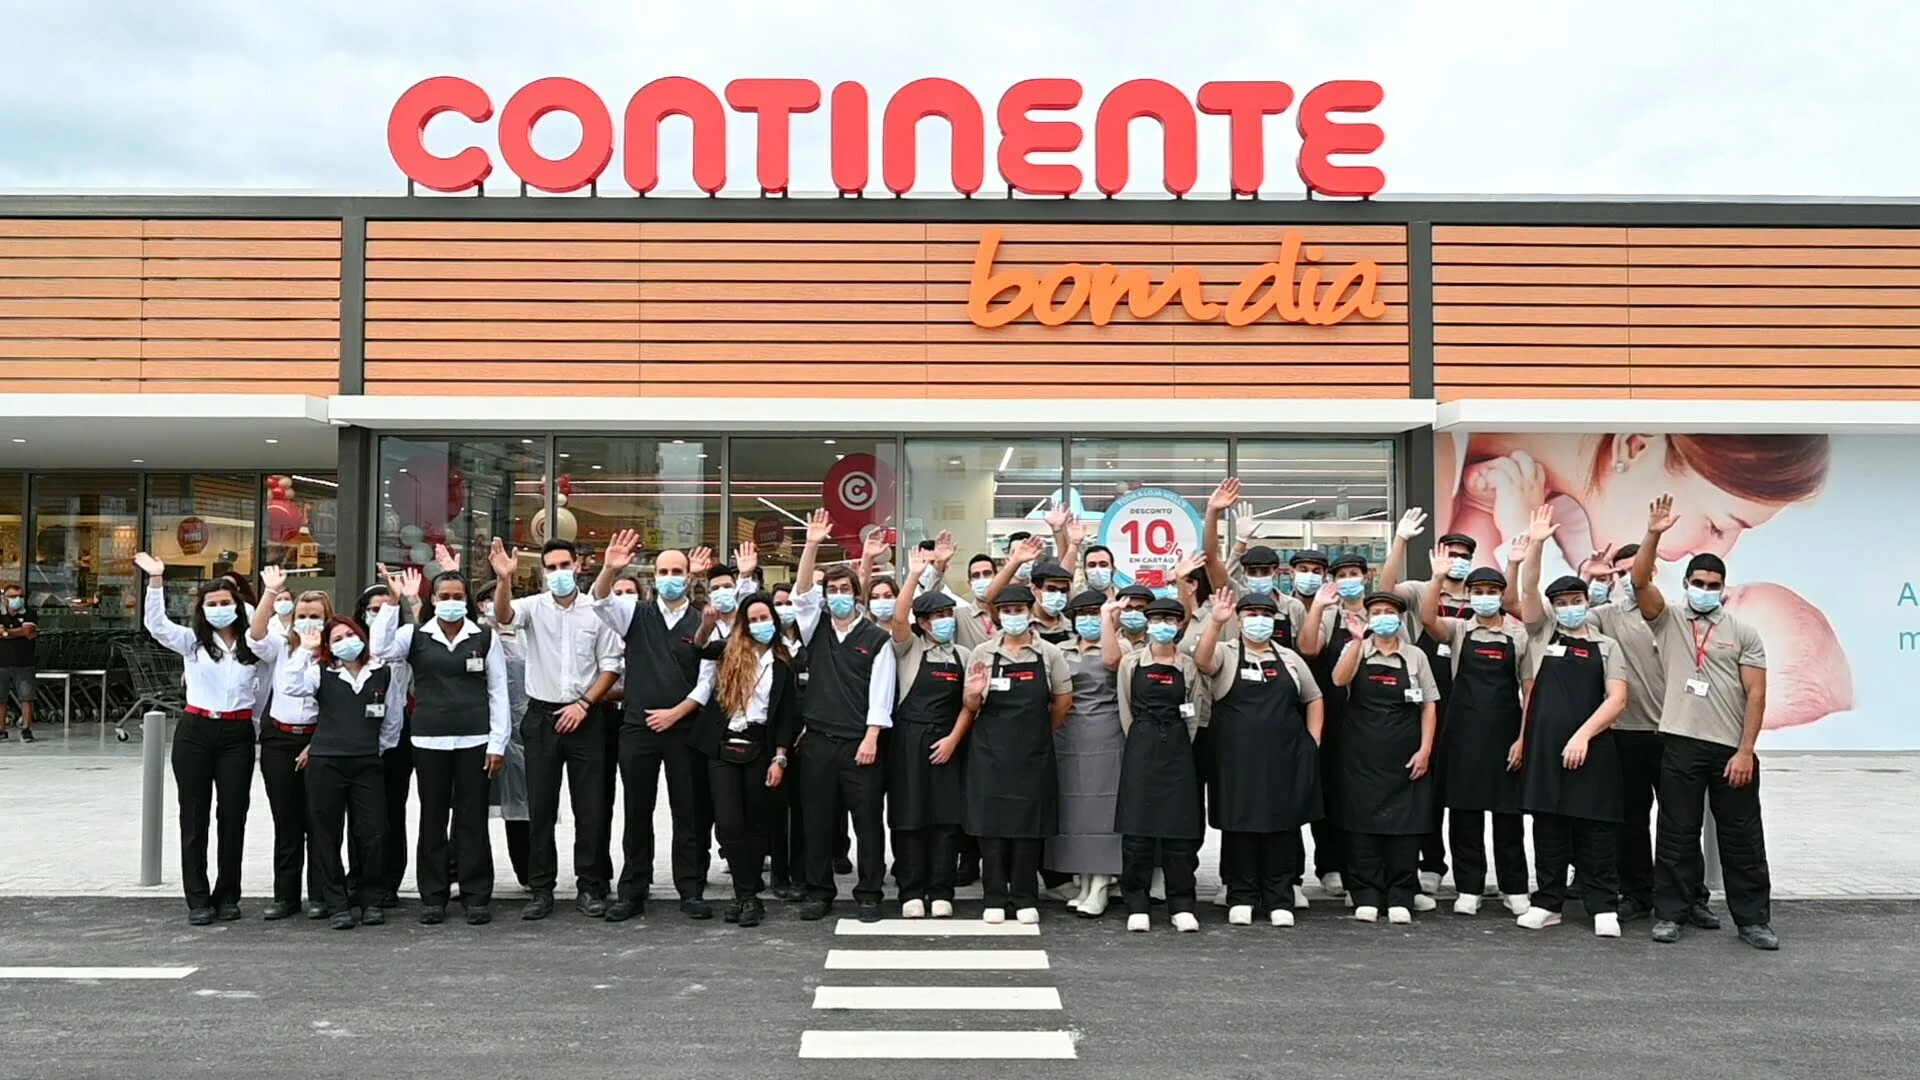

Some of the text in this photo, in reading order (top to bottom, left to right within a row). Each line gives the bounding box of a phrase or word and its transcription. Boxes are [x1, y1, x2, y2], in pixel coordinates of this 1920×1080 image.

[387, 76, 1386, 197] CONTINENTE
[966, 229, 1387, 328] bom dia
